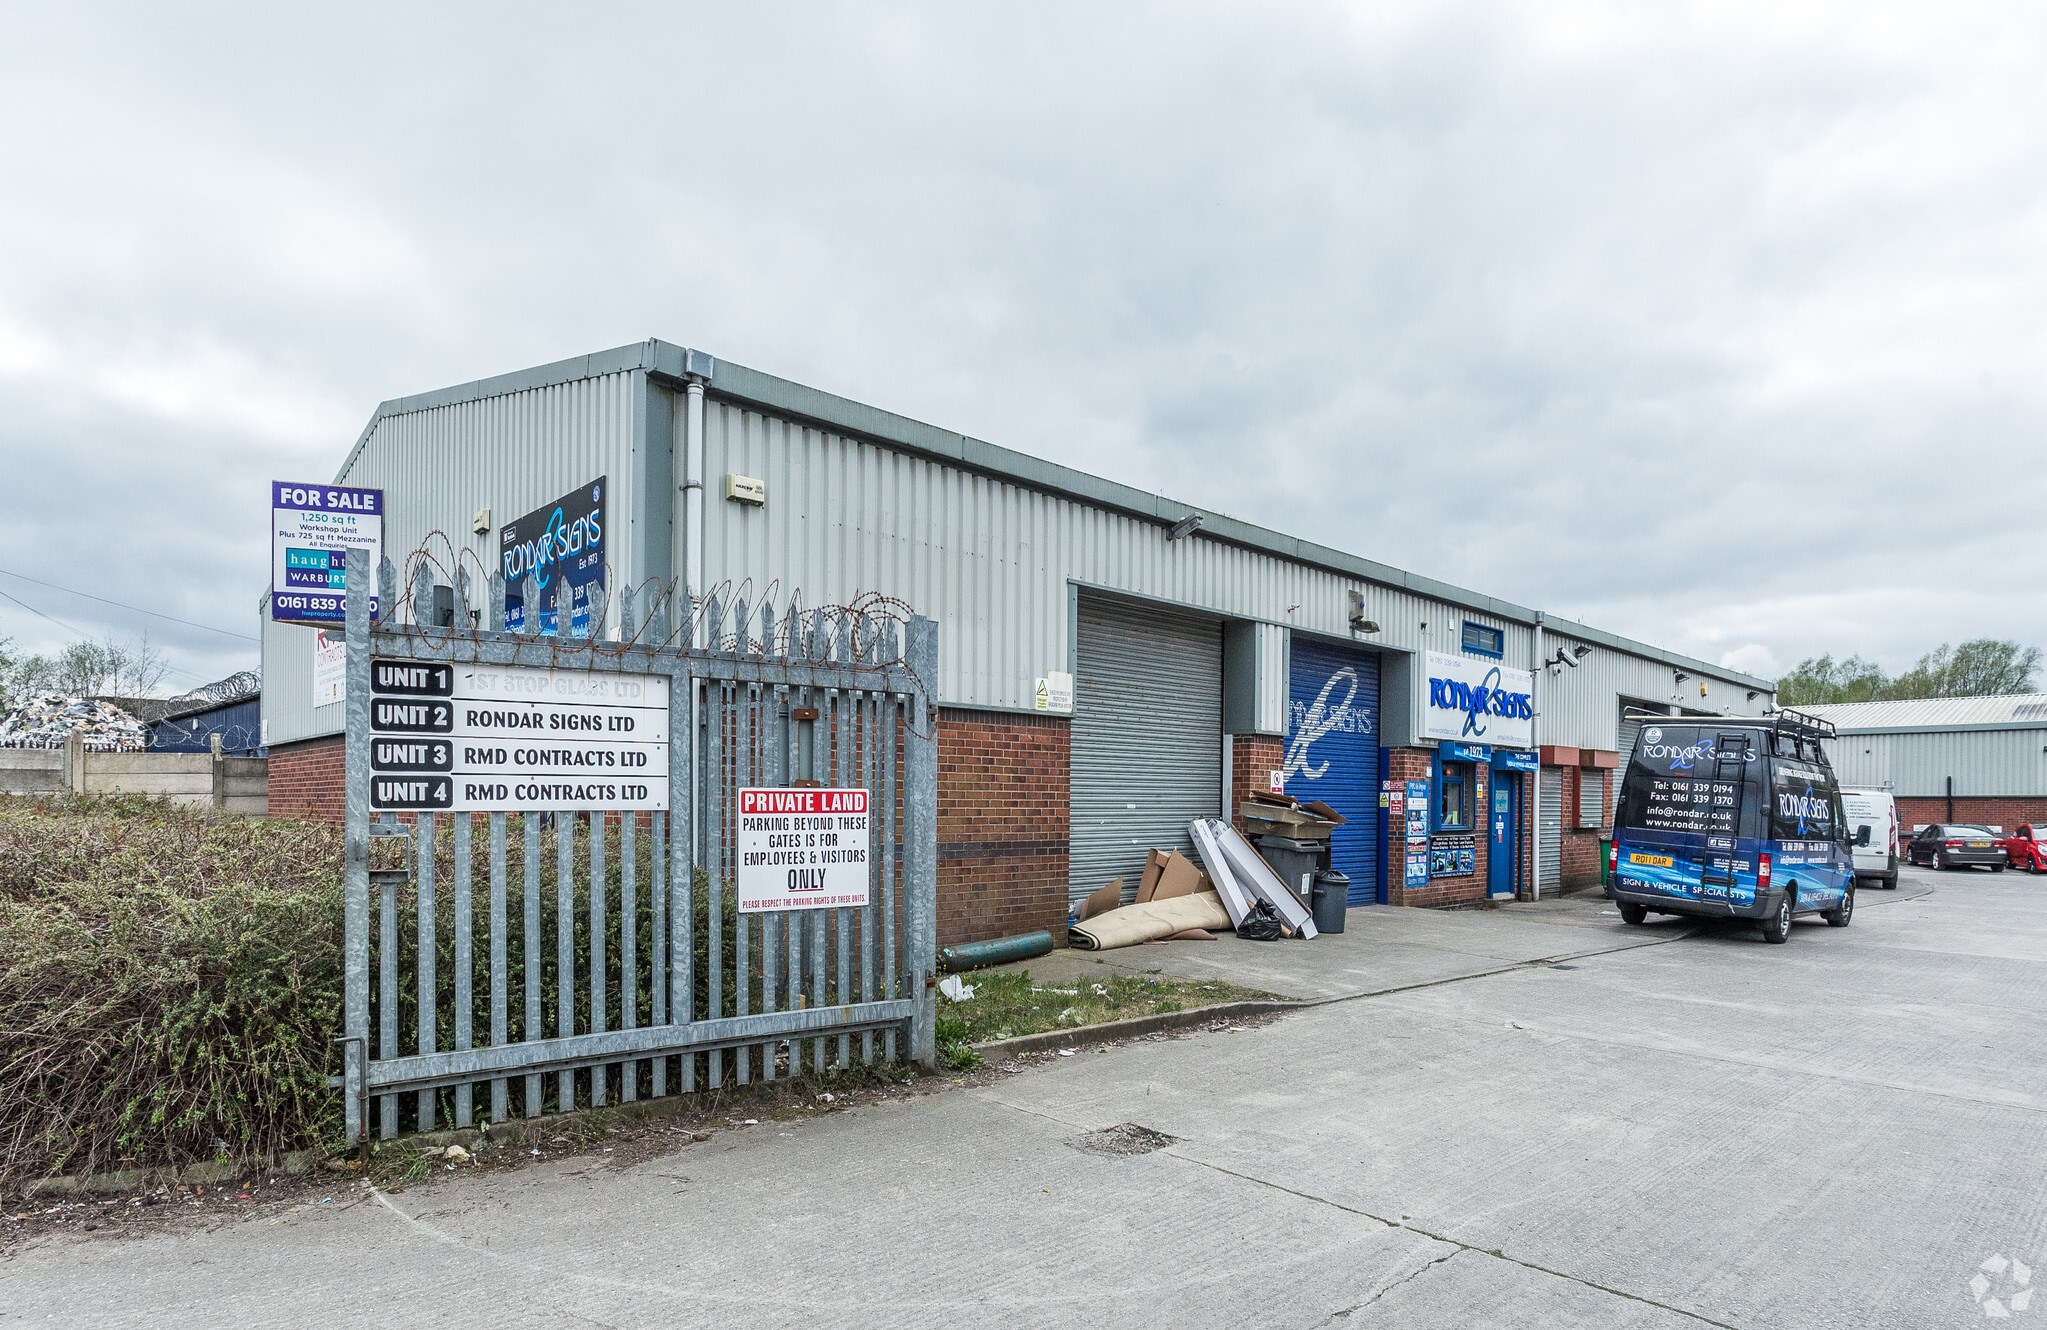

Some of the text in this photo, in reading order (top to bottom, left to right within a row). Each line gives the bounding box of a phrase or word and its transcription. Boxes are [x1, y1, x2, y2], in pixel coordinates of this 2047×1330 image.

[280, 487, 375, 511] FOR SALE
[301, 512, 356, 526] 1,250 sq ft
[279, 530, 296, 539] Plus
[299, 532, 313, 540] 725
[315, 534, 325, 542] sq
[337, 535, 377, 544] Mezzanine
[299, 524, 358, 535] Workshop Unit
[557, 508, 602, 560] SIGNS
[291, 553, 346, 568] haught
[587, 552, 598, 567] 1973
[291, 572, 346, 584] WARBURT
[277, 596, 378, 613] 0161 839 00
[301, 610, 346, 618] hwproperty.co
[378, 665, 430, 688] UNIT
[434, 669, 446, 689] 1
[504, 674, 550, 693] STOP
[554, 677, 609, 697] GLASS
[614, 680, 641, 699] LTD
[1429, 676, 1533, 721] RONDAR SIGNS
[378, 703, 635, 733] UNIT 2 RONDAR SIGNS LTD
[377, 743, 647, 767] UNIT 3 RMD CONTRACTS LTD
[1469, 745, 1483, 758] 1973
[1643, 744, 1704, 765] RONDAR
[378, 782, 648, 802] UNIT 4 RMD CONTRACTS LTD
[1653, 781, 1733, 794] Tel: 0161 339 0194
[744, 793, 864, 812] PRIVATE LAND
[1650, 791, 1733, 805] Fax: 0161 339 1370
[1779, 793, 1829, 828] RONDAR SIGNS
[743, 816, 867, 831] PARKING BEYOND THESE
[769, 833, 838, 848] GATES IS FOR
[744, 849, 866, 866] EMPLOYEES & VISITORS
[1652, 856, 1667, 865] DAR
[787, 868, 827, 890] ONLY
[1622, 877, 1746, 900] SIGN & VEHICLE SPECIALSTS
[742, 900, 760, 909] PLEASE
[761, 899, 782, 908] RESPECT
[783, 898, 792, 907] THE
[792, 897, 812, 906] PARKING
[813, 896, 830, 905] RIGHTS
[830, 896, 836, 904] OF
[837, 895, 851, 904] THESE
